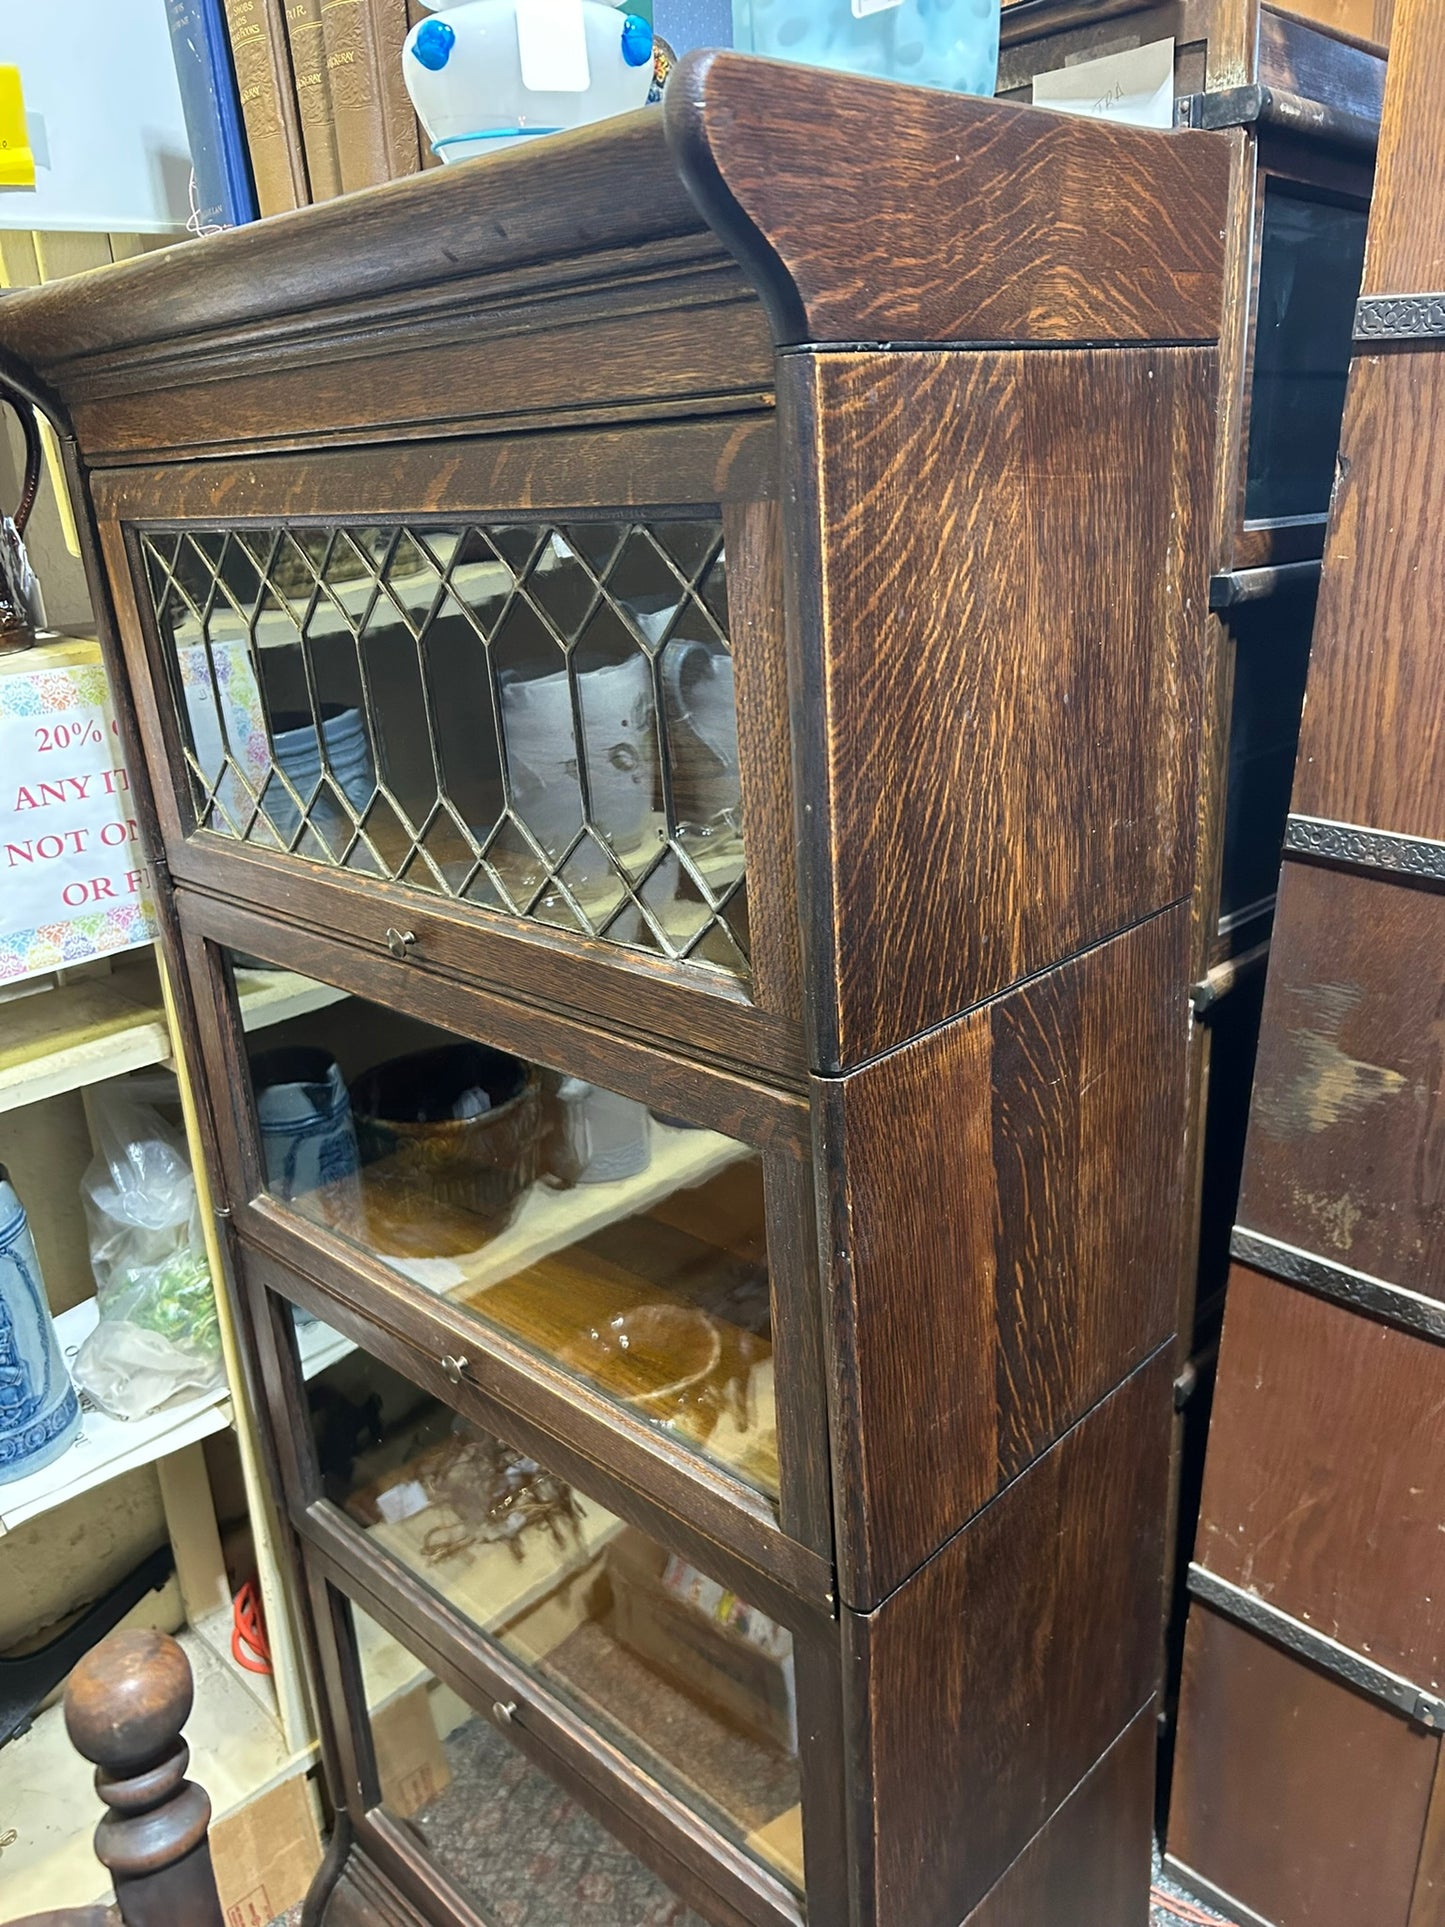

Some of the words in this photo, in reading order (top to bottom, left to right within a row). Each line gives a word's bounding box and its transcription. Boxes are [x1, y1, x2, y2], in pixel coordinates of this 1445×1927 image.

[34, 720, 102, 753] 20%
[13, 774, 92, 811] ANY
[4, 829, 90, 867] NOT
[62, 876, 118, 907] OR
